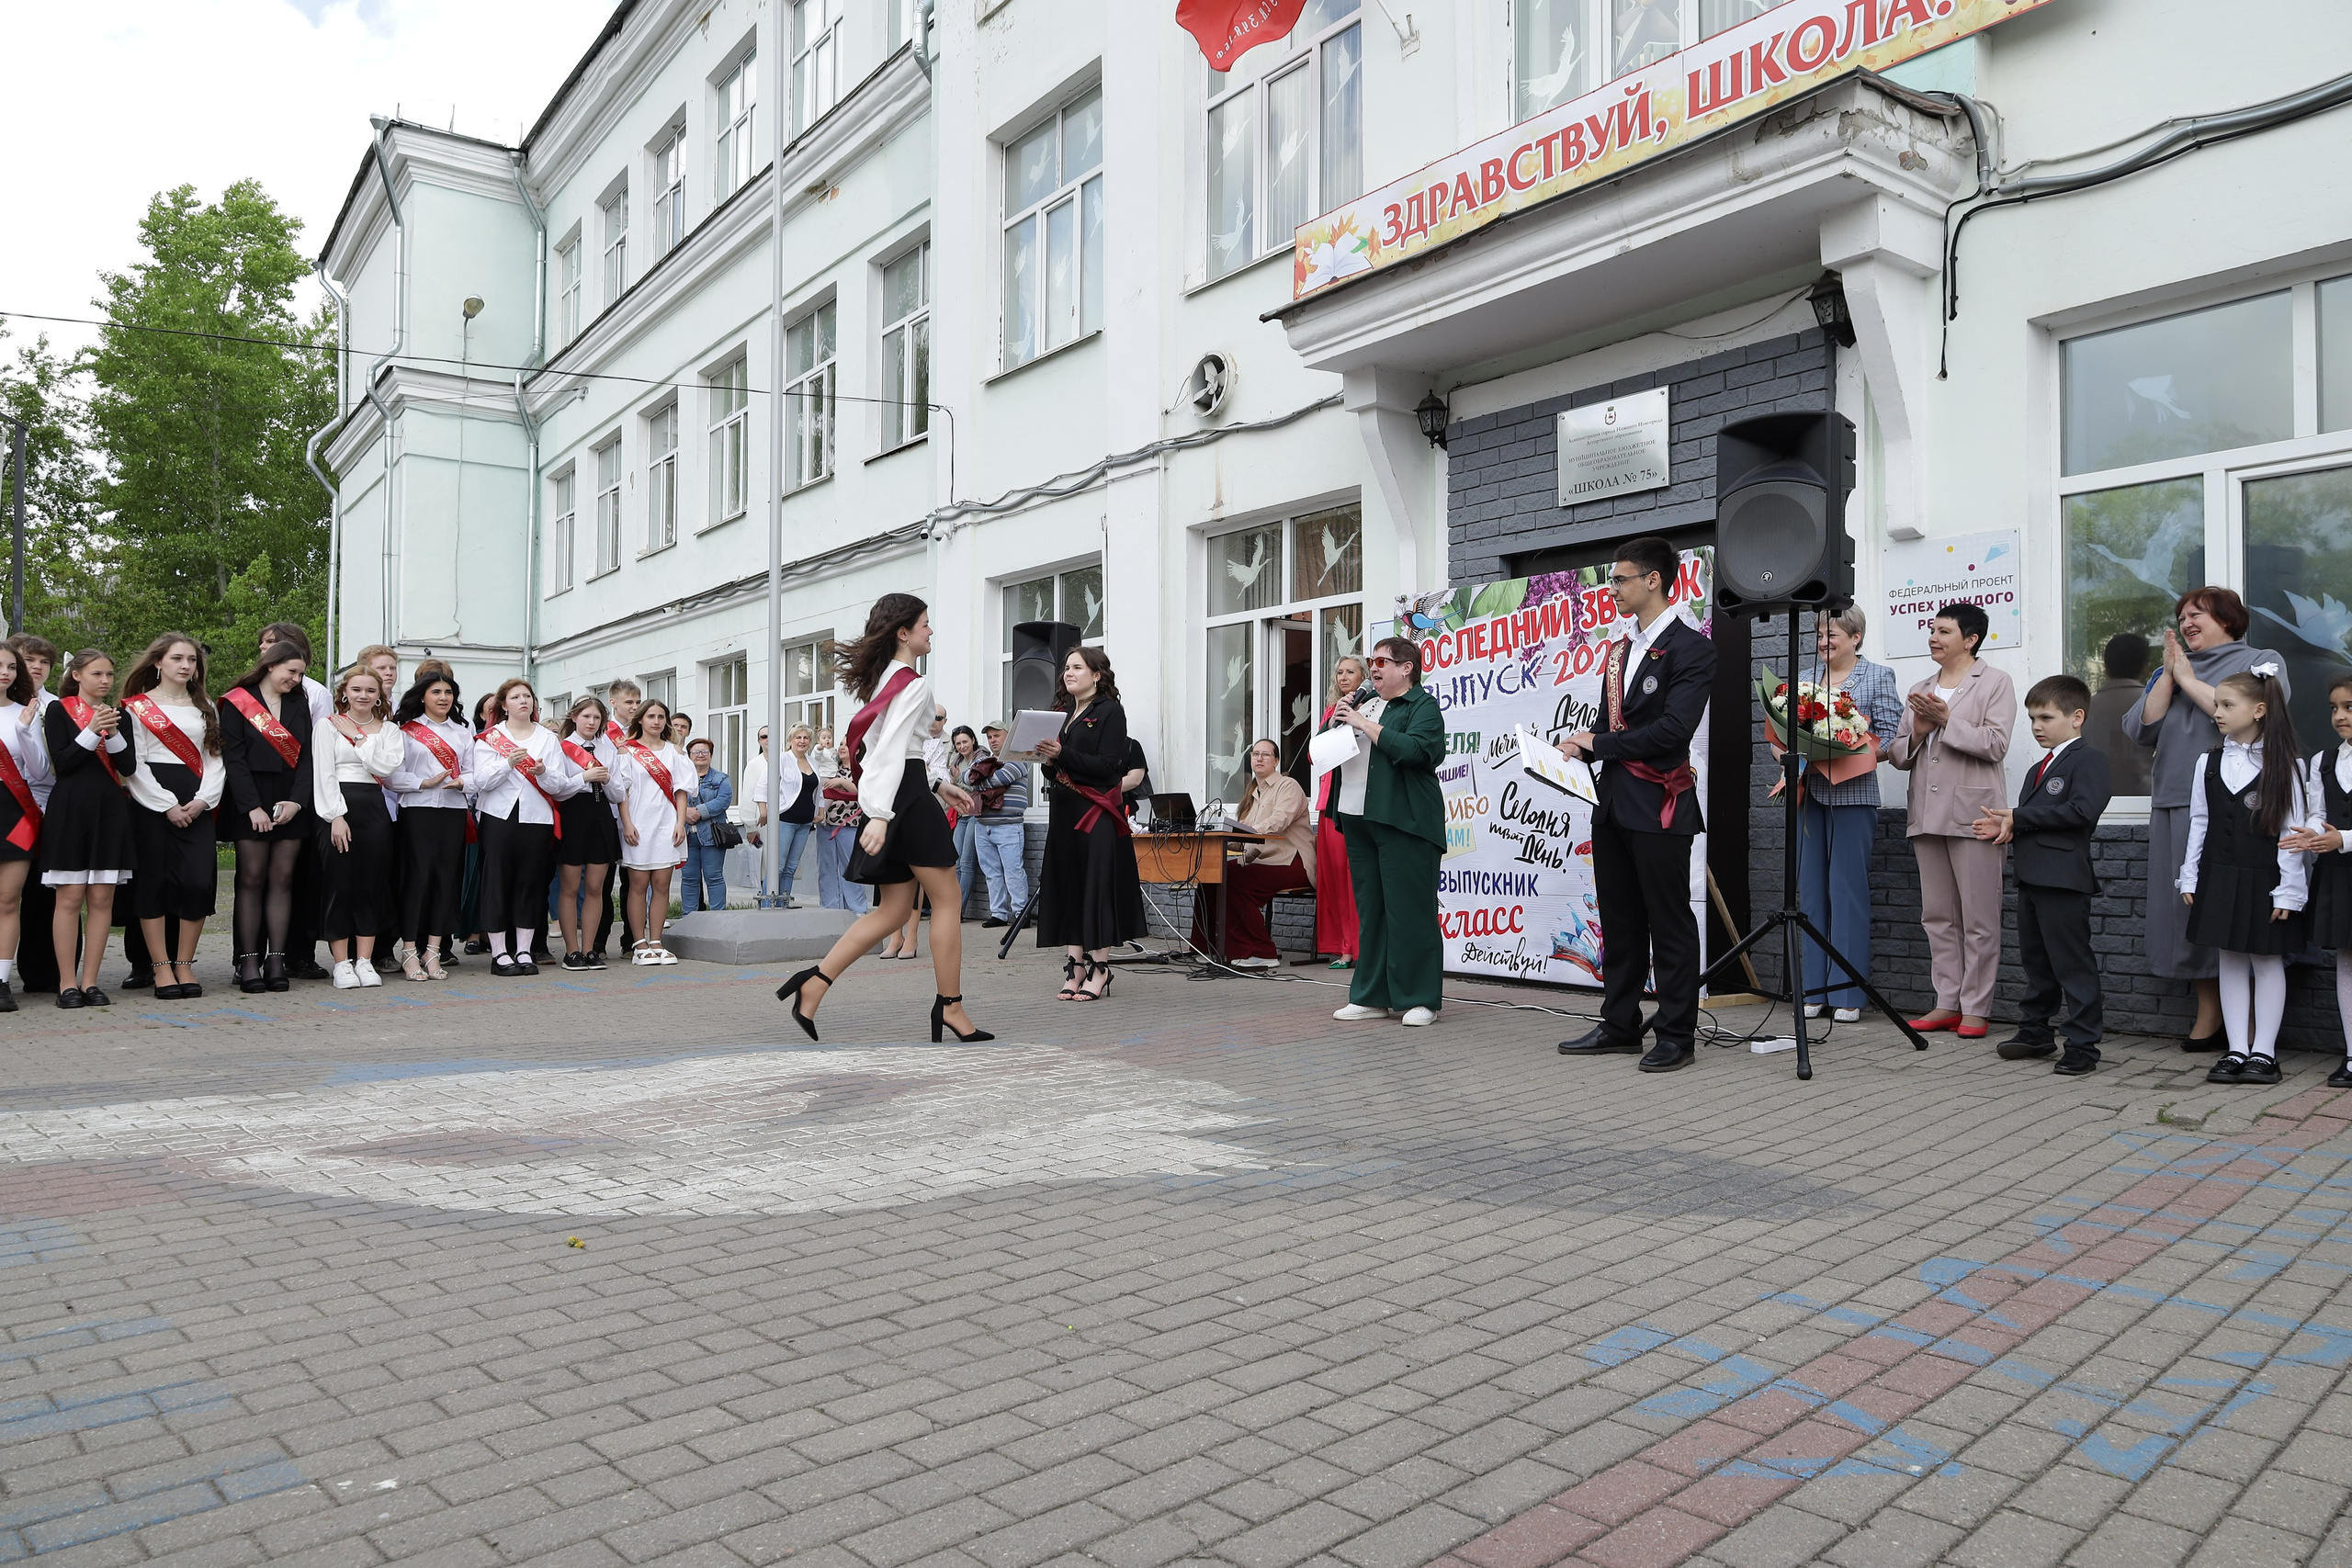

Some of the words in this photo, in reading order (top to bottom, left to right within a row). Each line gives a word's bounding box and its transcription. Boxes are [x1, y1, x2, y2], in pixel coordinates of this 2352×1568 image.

[1382, 82, 1669, 248] ЗДРАВСТВУЙ,
[1688, 0, 1952, 120] ШКОЛА
[1568, 447, 1617, 464] МУНИЦИПАЛЬНОЕ
[1618, 439, 1657, 453] БЮДЖЕТНОЕ
[1577, 448, 1646, 468] ОБЩЕОБРАЗОВАТЕЛЬНОЕ
[1592, 459, 1631, 471] УЧРЕЖДЕНИЕ
[1568, 476, 1620, 495] «ШКОЛА
[1623, 472, 1637, 484] №
[1640, 468, 1657, 481] 75»
[1889, 580, 1968, 599] ФЕДЕРАЛЬНЫЙ
[1972, 574, 2014, 589] ПРОЕКТ
[1419, 594, 1571, 673] ОСЛЕДНИЙ
[1581, 559, 1703, 629] ЗВОК
[1890, 600, 1935, 616] УСПЕХ
[1553, 639, 1612, 687] 202
[147, 714, 199, 765] Выпускница
[1443, 731, 1480, 755] ЕЛЯ!
[1437, 763, 1469, 783] ЧШИЕ!
[1499, 781, 1571, 839] Сегодня
[1488, 821, 1526, 845] твой
[1513, 834, 1573, 874] День!
[1439, 870, 1539, 897] ВЫПУСКНИК
[1461, 937, 1549, 979] Действуй!
